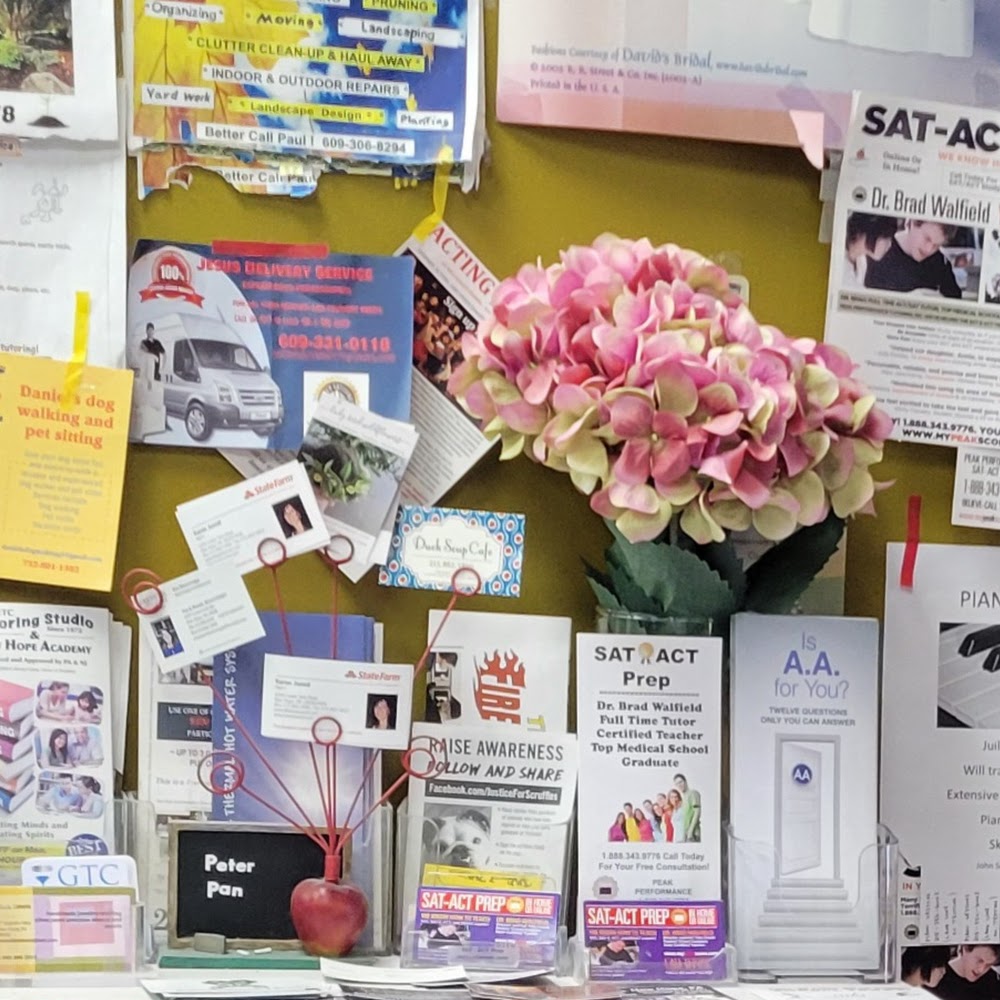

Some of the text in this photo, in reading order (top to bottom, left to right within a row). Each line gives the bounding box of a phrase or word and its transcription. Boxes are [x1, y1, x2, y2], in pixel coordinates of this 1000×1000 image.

[152, 3, 217, 21] Organizing
[372, 0, 428, 11] PRUNING
[257, 14, 314, 30] Moving
[361, 21, 435, 42] Landscaping
[196, 38, 413, 68] CLUTTER CLEAN-UP & HAUL AWAY
[622, 47, 669, 65] David's
[212, 68, 400, 96] INDOOR & OUTDOOR REPAIRS
[146, 88, 210, 103] Yard work
[251, 102, 362, 121] Landscape Design
[400, 113, 449, 127] Planting
[205, 126, 245, 141] Better
[250, 130, 274, 143] Call
[322, 137, 407, 154] 609-306-8294
[938, 152, 955, 162] WE
[957, 154, 989, 167] KNOW
[871, 187, 889, 211] Dr.
[894, 189, 926, 216] Brad
[930, 194, 990, 224] Walfield
[431, 226, 495, 295] ACTING
[86, 394, 115, 413] dog
[17, 405, 114, 429] walking and
[25, 427, 103, 449] pet sitting
[0, 613, 94, 629] oring Studio
[30, 631, 39, 640] &
[802, 632, 817, 650] Is
[594, 646, 699, 664] SAT ACT
[783, 650, 840, 676] A.A.
[623, 671, 670, 690] Prep
[775, 678, 850, 700] for You?
[597, 701, 702, 713] Dr. Brad Walfield
[769, 707, 848, 716] TWELVE QUESTIONS
[600, 715, 696, 726] Full Time Tutor
[783, 717, 800, 725] YOU
[223, 728, 235, 750] HOT
[597, 729, 703, 740] Certified Teacher
[430, 738, 563, 761] RAISE AWARENESS
[591, 743, 709, 754] Top Medical School
[622, 758, 679, 767] Graduate
[963, 765, 985, 776] Will
[485, 765, 516, 779] AND
[519, 767, 563, 781] SHARE
[947, 789, 1000, 800] Extensive
[21, 821, 49, 829] Minds
[205, 854, 255, 873] Peter
[680, 853, 705, 862] Today
[57, 864, 120, 886] GTC
[615, 863, 634, 871] Your
[636, 863, 654, 871] Free
[656, 863, 710, 871] Consultation!
[207, 881, 244, 899] Pan
[635, 888, 692, 896] PERFORMANCE
[421, 892, 506, 911] SAT-ACT PREP
[587, 907, 639, 925] SAT-ACT
[640, 908, 669, 925] PREP
